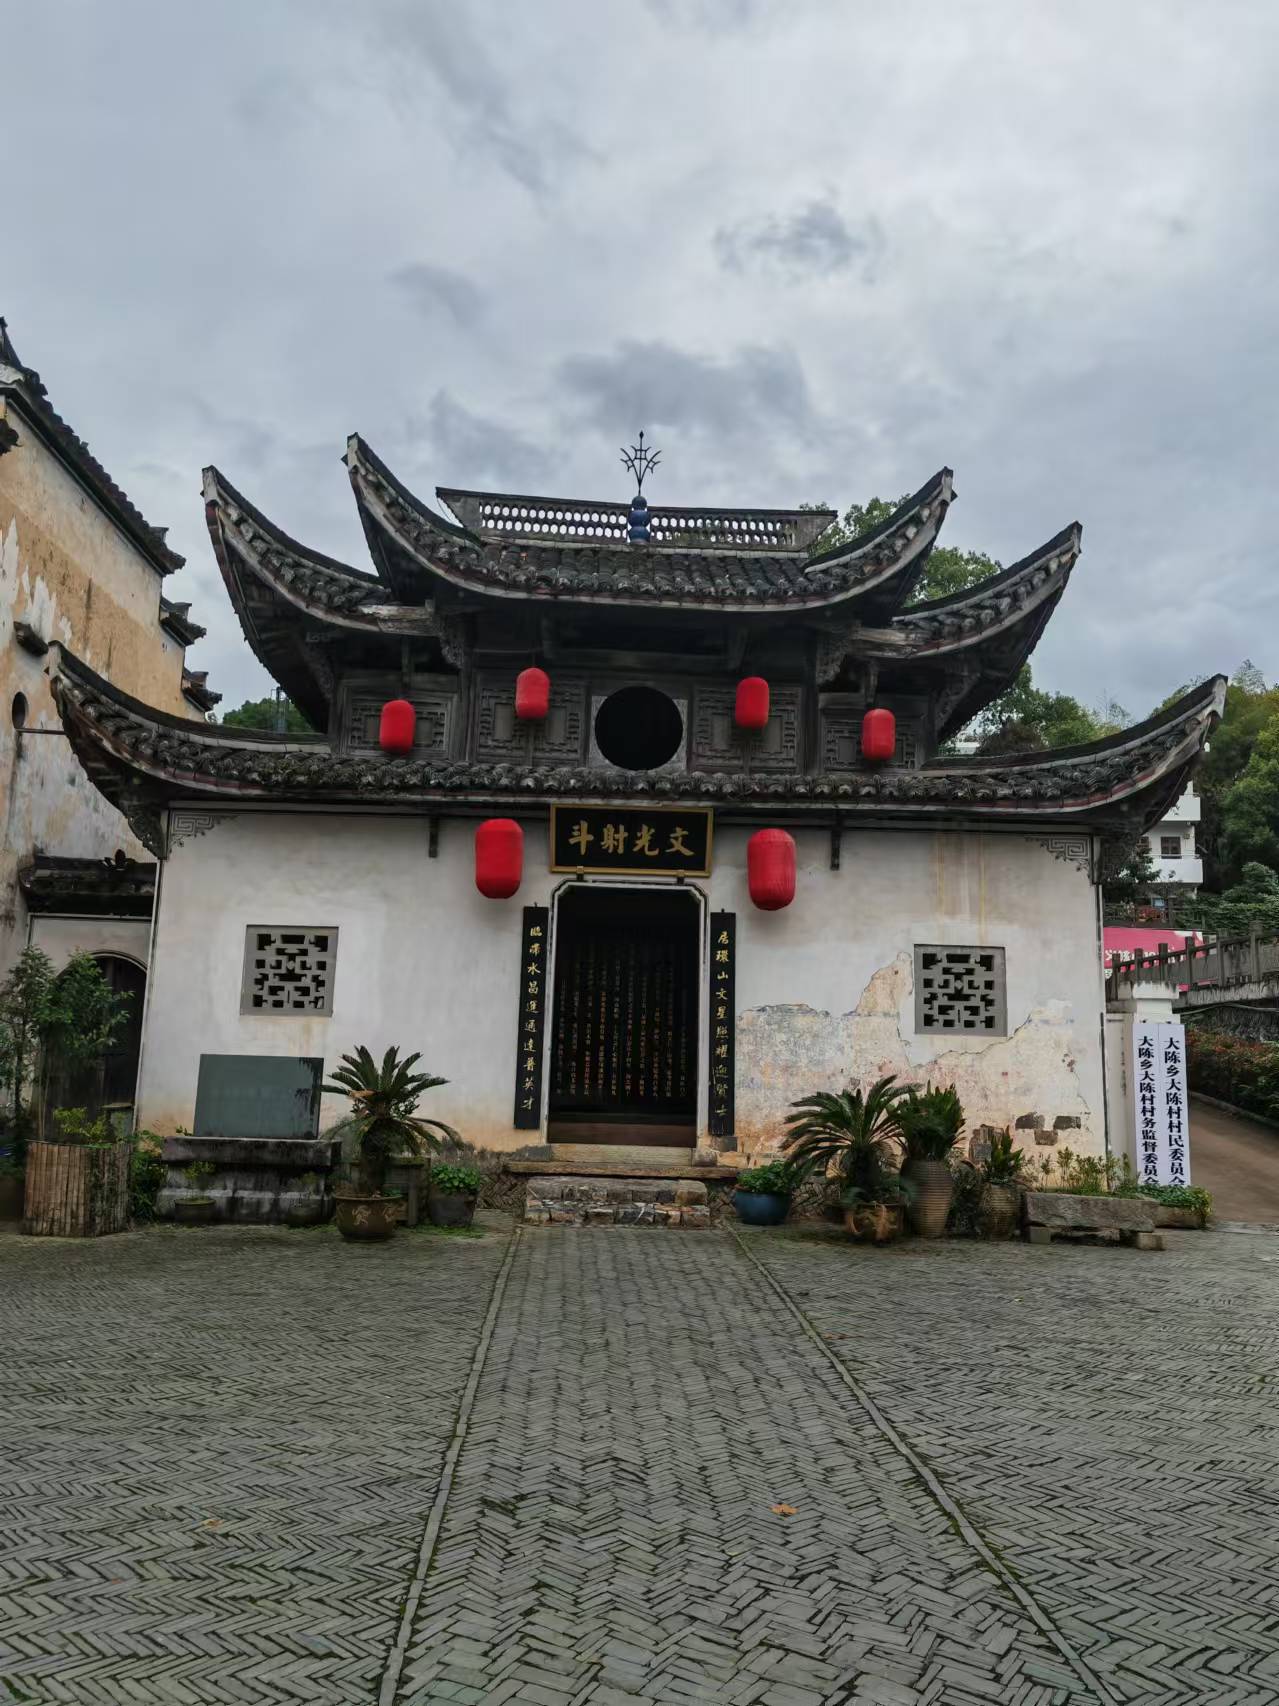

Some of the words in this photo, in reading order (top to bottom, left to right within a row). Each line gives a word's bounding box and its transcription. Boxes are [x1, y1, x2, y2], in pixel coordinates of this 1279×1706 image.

[1138, 1035, 1160, 1185] 大陈乡大陈村村务监督委员会
[1164, 1037, 1186, 1185] 大陈乡大陈村村民委员会
